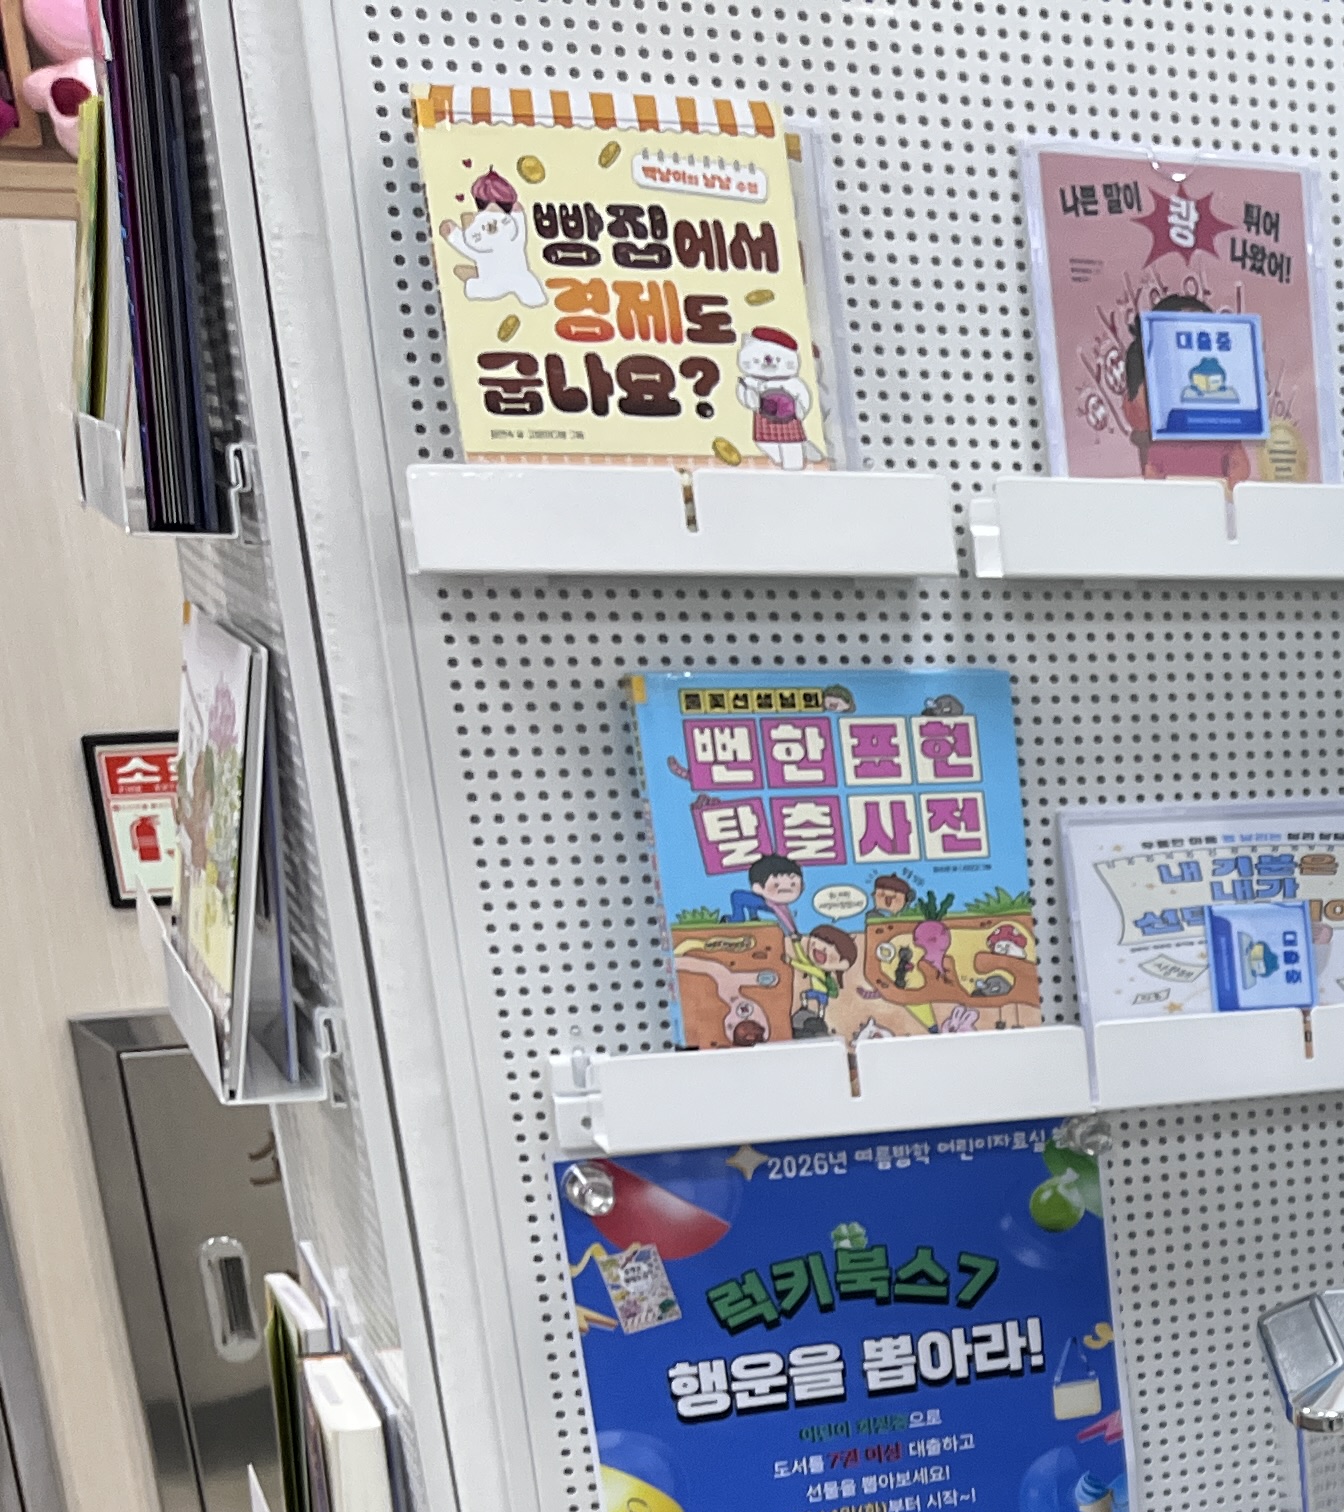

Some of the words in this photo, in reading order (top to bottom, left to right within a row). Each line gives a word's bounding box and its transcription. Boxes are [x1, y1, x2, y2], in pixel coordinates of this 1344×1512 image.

[1103, 181, 1143, 215] 말이
[532, 200, 781, 275] 빵집에서
[545, 276, 737, 345] 경제도
[476, 350, 721, 418] 굽나요?
[692, 722, 827, 785] 뻔한
[849, 720, 975, 780] 표현
[701, 801, 838, 868] 탈출
[859, 797, 983, 860] 사전
[1157, 860, 1204, 885] 내
[1209, 877, 1301, 902] 내가
[767, 1149, 849, 1181] 2026년
[854, 1141, 931, 1171] 여름방학
[936, 1128, 1047, 1163] 어린이자료실
[667, 1340, 847, 1420] 행운을
[862, 1316, 1046, 1394] 뽑아라!
[772, 1454, 825, 1480] 도서를
[908, 1433, 976, 1460] 대출하고
[805, 1476, 857, 1504] 선물을
[861, 1464, 951, 1496] 뽑아보세요!
